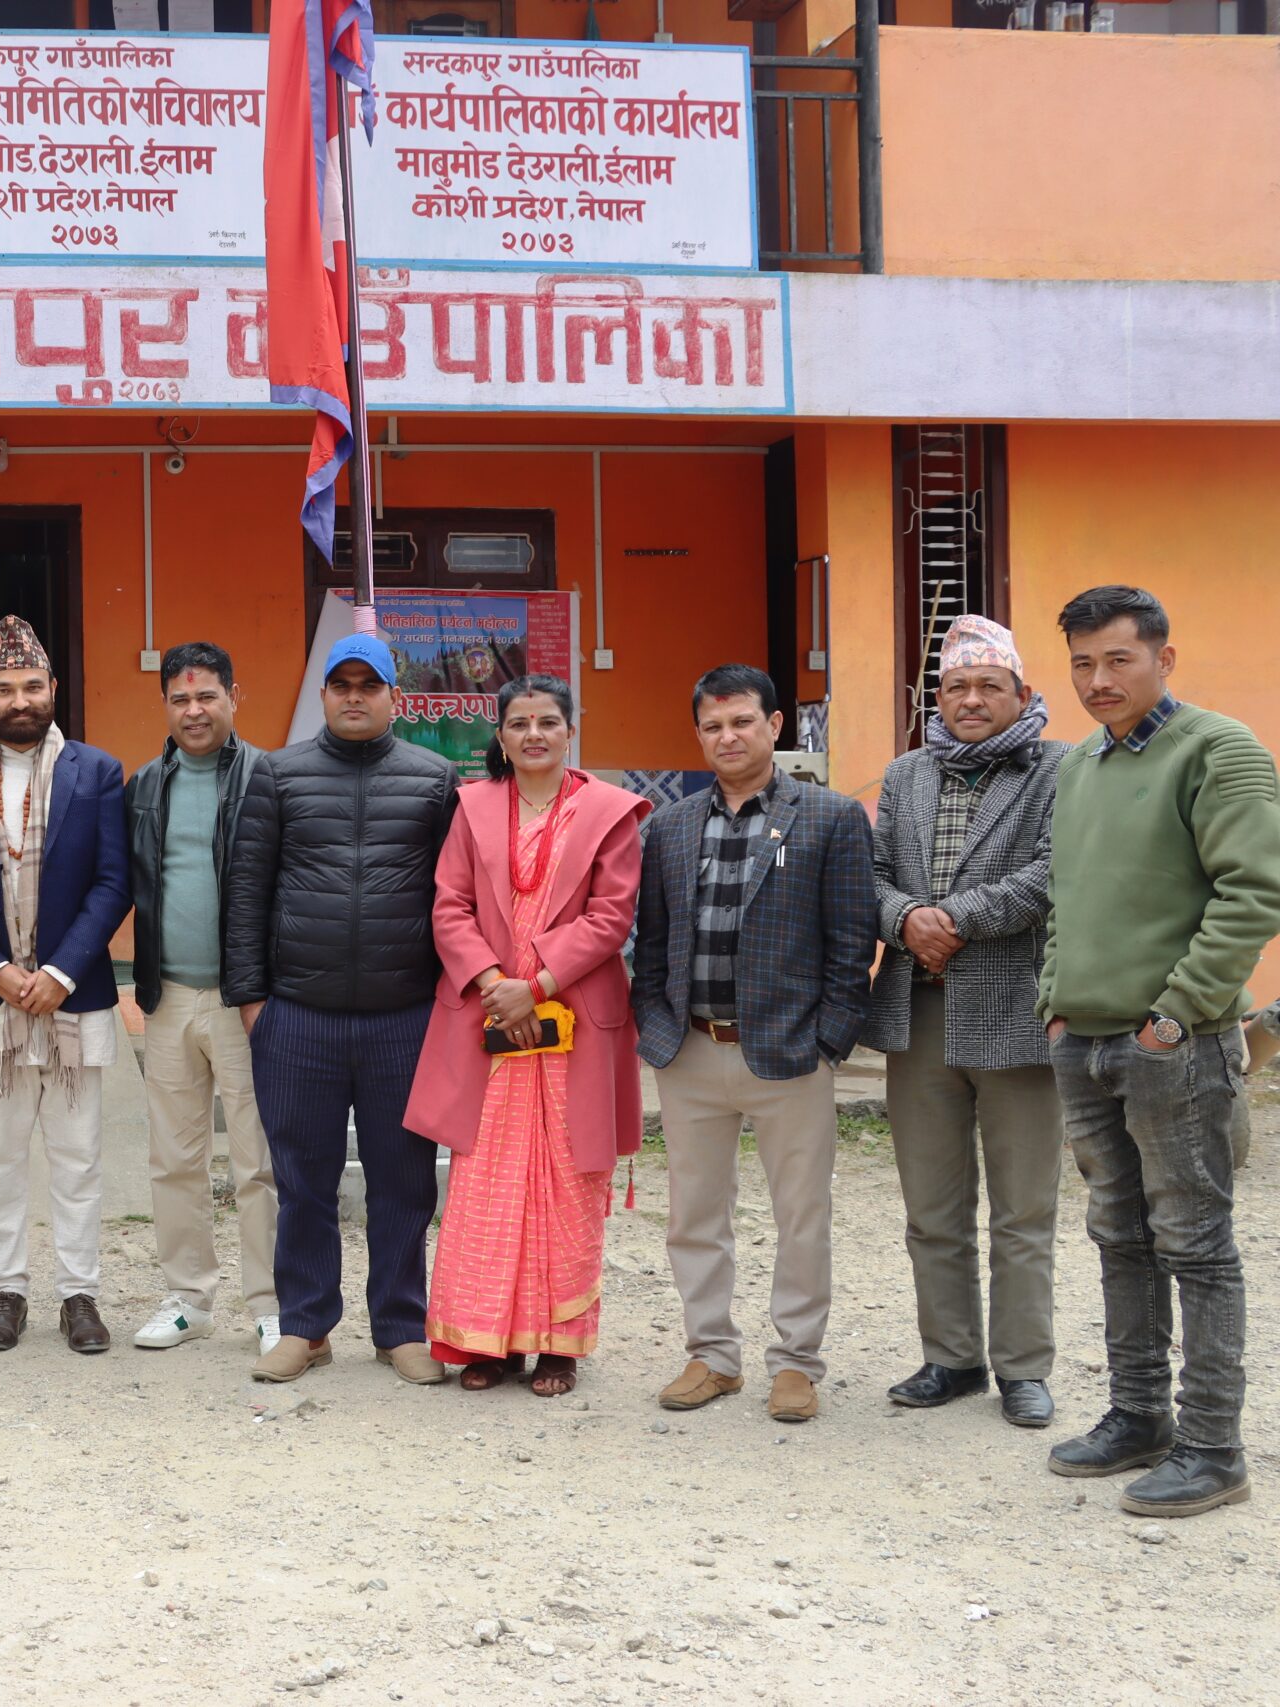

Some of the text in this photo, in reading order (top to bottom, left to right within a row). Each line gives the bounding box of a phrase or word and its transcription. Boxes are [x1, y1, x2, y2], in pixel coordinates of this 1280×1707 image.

[46, 38, 175, 69] गाउँपालिका
[403, 48, 641, 81] सन्दकपुर गाउँपालिका
[130, 77, 266, 127] सचिवालय
[385, 82, 608, 137] कार्यपालिकाको
[613, 89, 741, 140] कार्यालय
[395, 141, 501, 189] माबुमोड
[411, 183, 489, 221] कोशी
[51, 224, 120, 251] २०७३
[501, 231, 575, 256] २०७३
[226, 263, 776, 387] उँपालिका
[382, 612, 437, 630] ऐतिहासिक
[389, 693, 499, 724] मन्त्रणा
